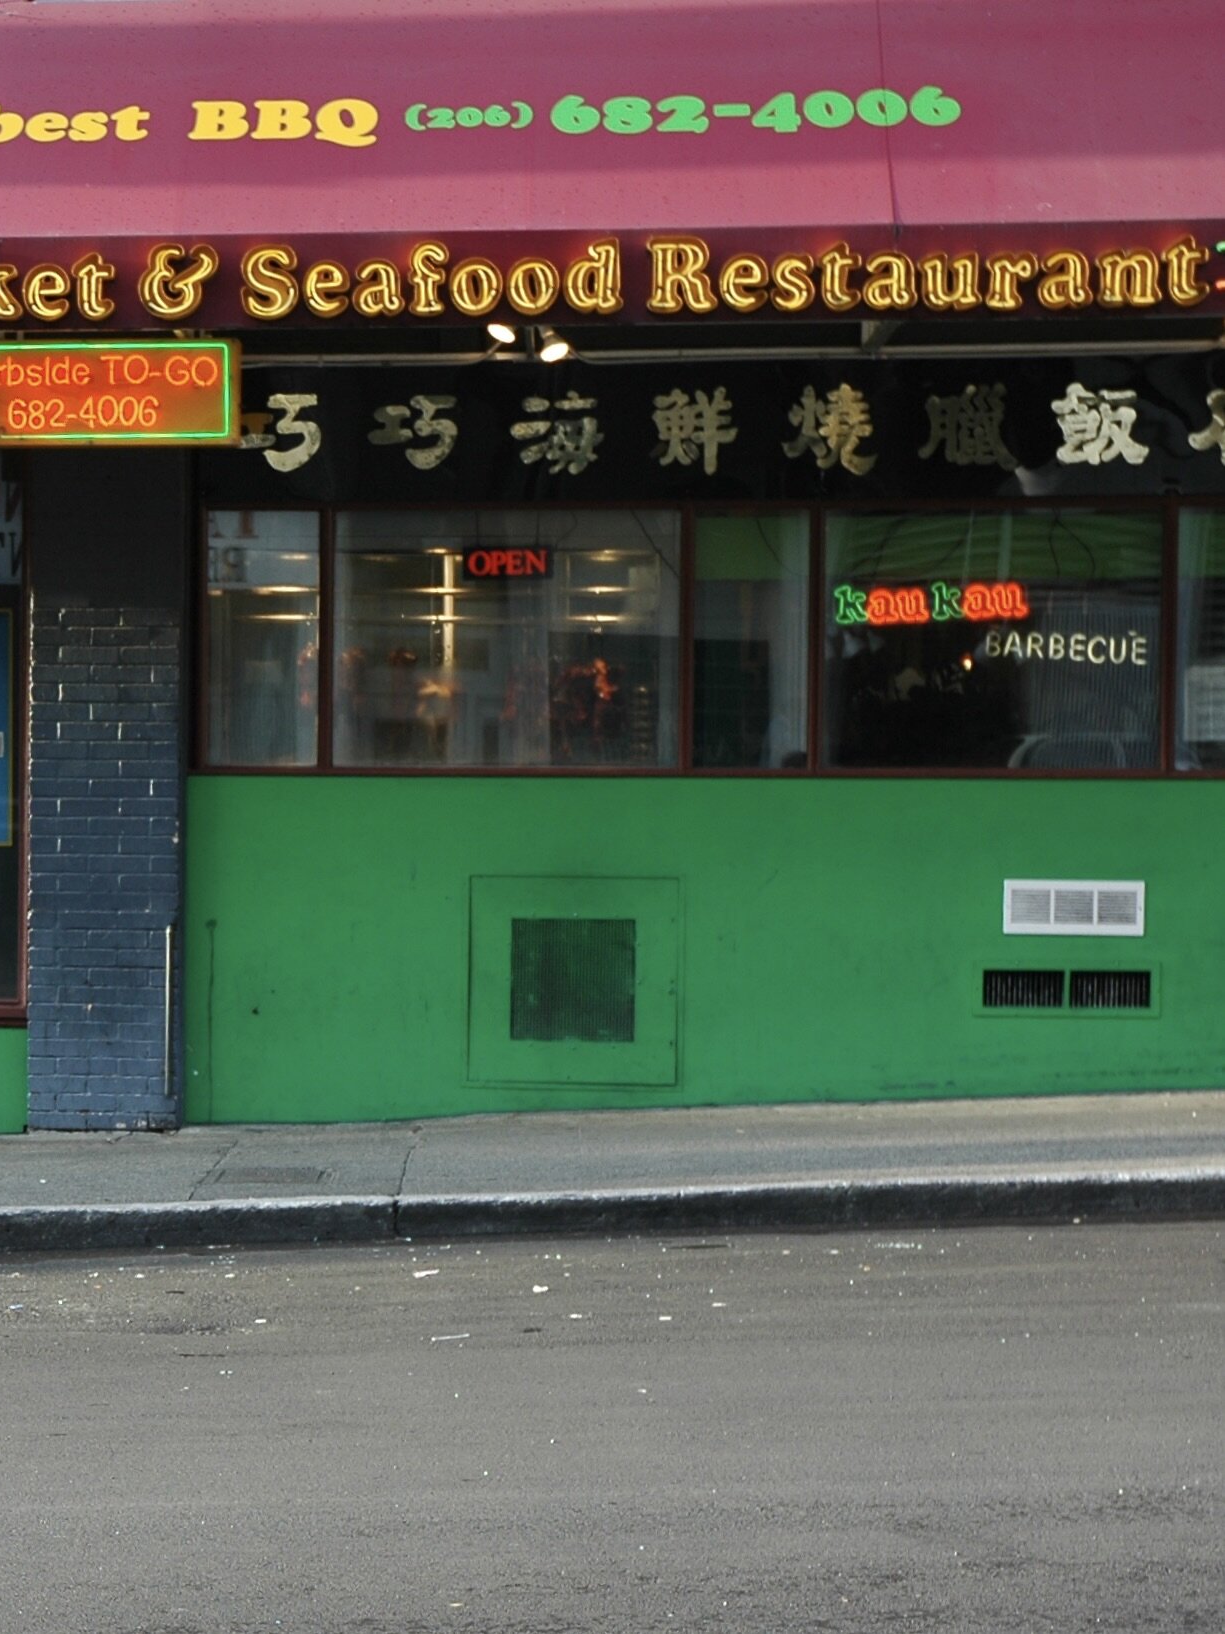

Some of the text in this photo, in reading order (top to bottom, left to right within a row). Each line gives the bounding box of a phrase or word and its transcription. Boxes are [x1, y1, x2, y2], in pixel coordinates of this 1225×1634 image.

[187, 98, 378, 147] BBQ
[404, 101, 534, 131] (206)
[550, 86, 962, 134] 682-4006
[137, 243, 218, 321] &
[240, 236, 623, 318] Seafood
[645, 234, 1211, 315] Restaurant
[100, 353, 218, 387] TO-GO
[7, 394, 160, 430] 682-4006
[467, 549, 547, 577] OPEN
[985, 630, 1147, 665] BARBECUE
